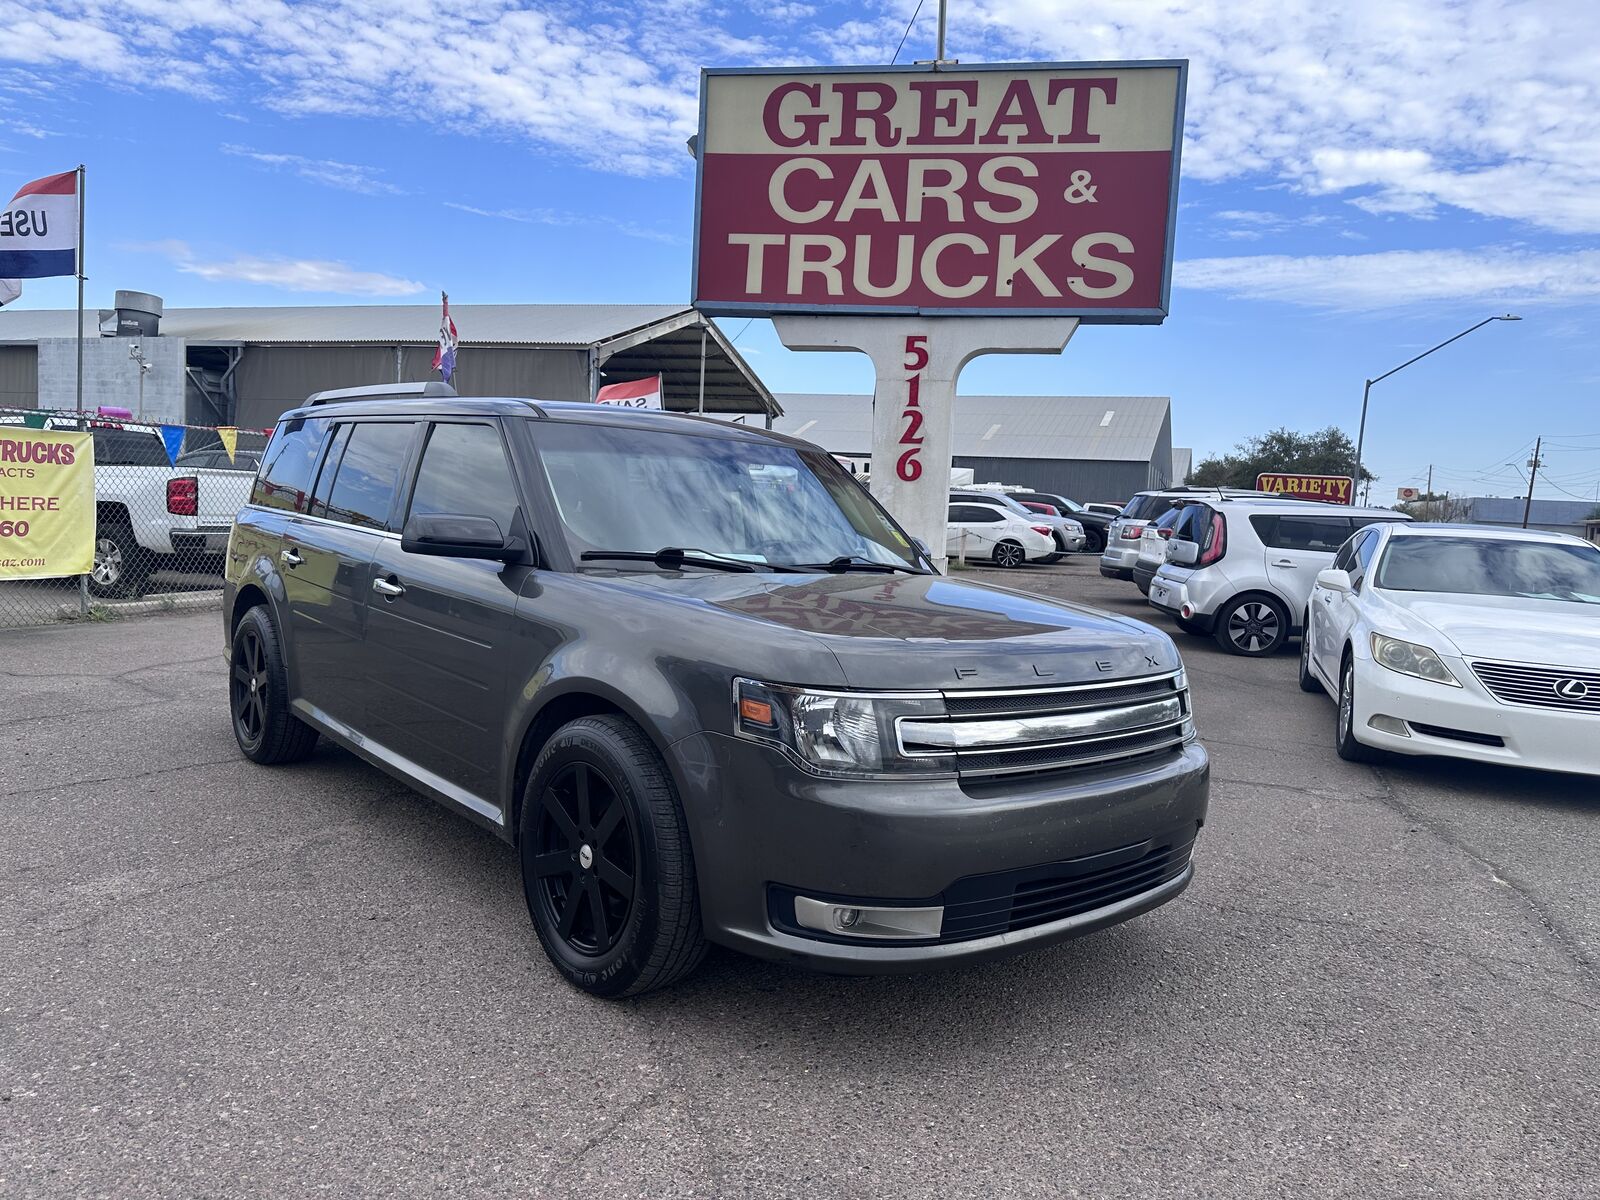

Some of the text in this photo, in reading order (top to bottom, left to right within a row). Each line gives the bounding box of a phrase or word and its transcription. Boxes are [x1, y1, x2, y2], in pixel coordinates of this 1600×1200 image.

[762, 77, 1118, 148] GREAT
[768, 155, 1098, 224] CARS &
[728, 232, 1135, 299] TRUCKS
[895, 335, 929, 482] 5126
[0, 439, 76, 466] RUCKS
[1261, 477, 1349, 498] VARIETY
[0, 496, 60, 511] HERE
[0, 520, 30, 537] 60
[0, 557, 46, 567] az.com
[953, 655, 1160, 681] FLEX
